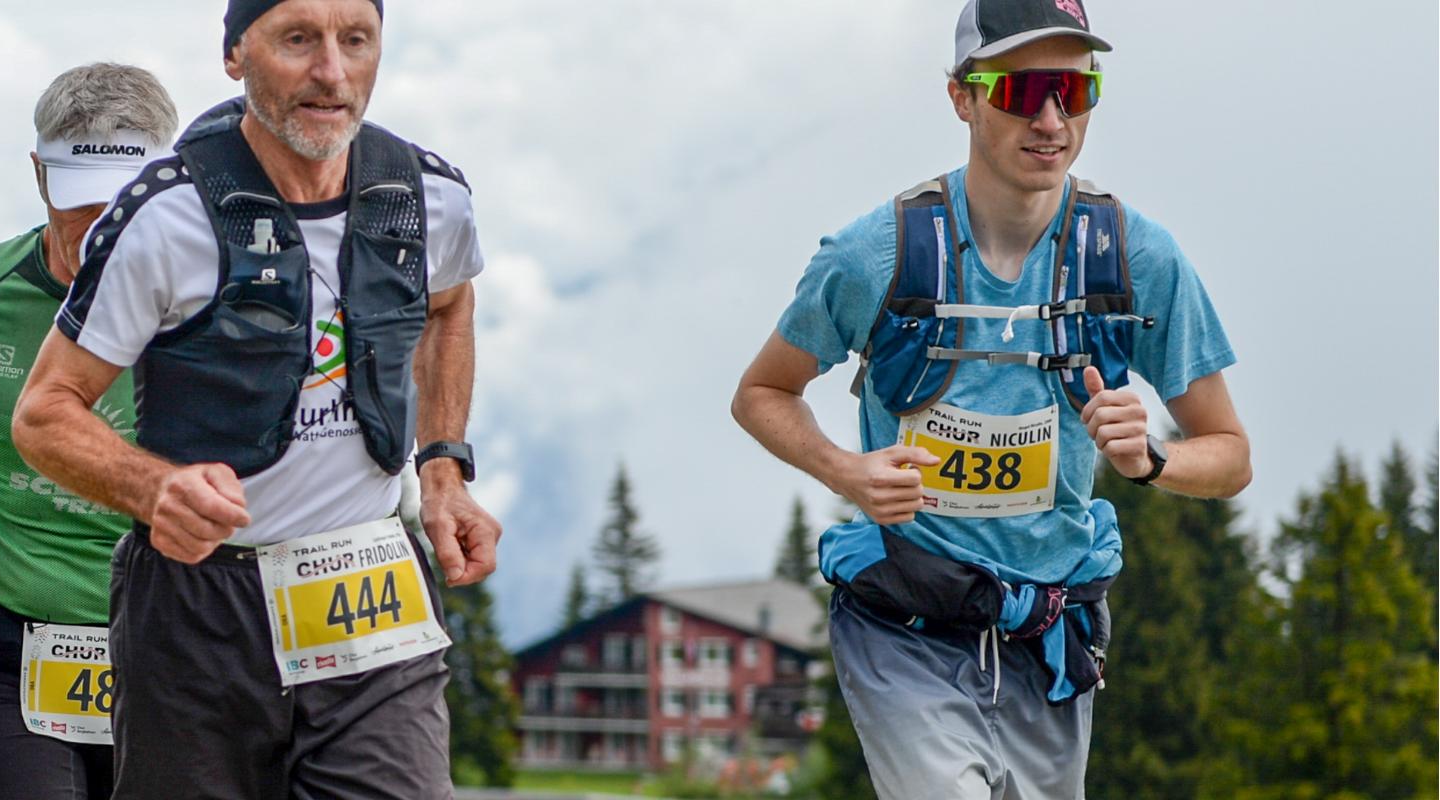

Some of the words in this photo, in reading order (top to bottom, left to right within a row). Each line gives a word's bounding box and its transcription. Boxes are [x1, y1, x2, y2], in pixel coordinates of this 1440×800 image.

[71, 144, 146, 157] SALOMON
[928, 407, 956, 422] TRAIL
[959, 418, 982, 428] RUN
[926, 420, 980, 443] CHUR
[990, 425, 1052, 447] NICULIN
[939, 450, 1022, 490] 438
[292, 545, 328, 557] TRAIL
[331, 539, 352, 549] RUN
[297, 553, 355, 578] CHUR
[358, 541, 410, 568] FRIDOLIN
[327, 571, 401, 635] 444
[52, 633, 82, 642] TRAIL
[51, 644, 106, 660] CHUR
[286, 658, 309, 672] IBC
[67, 668, 114, 714] 48
